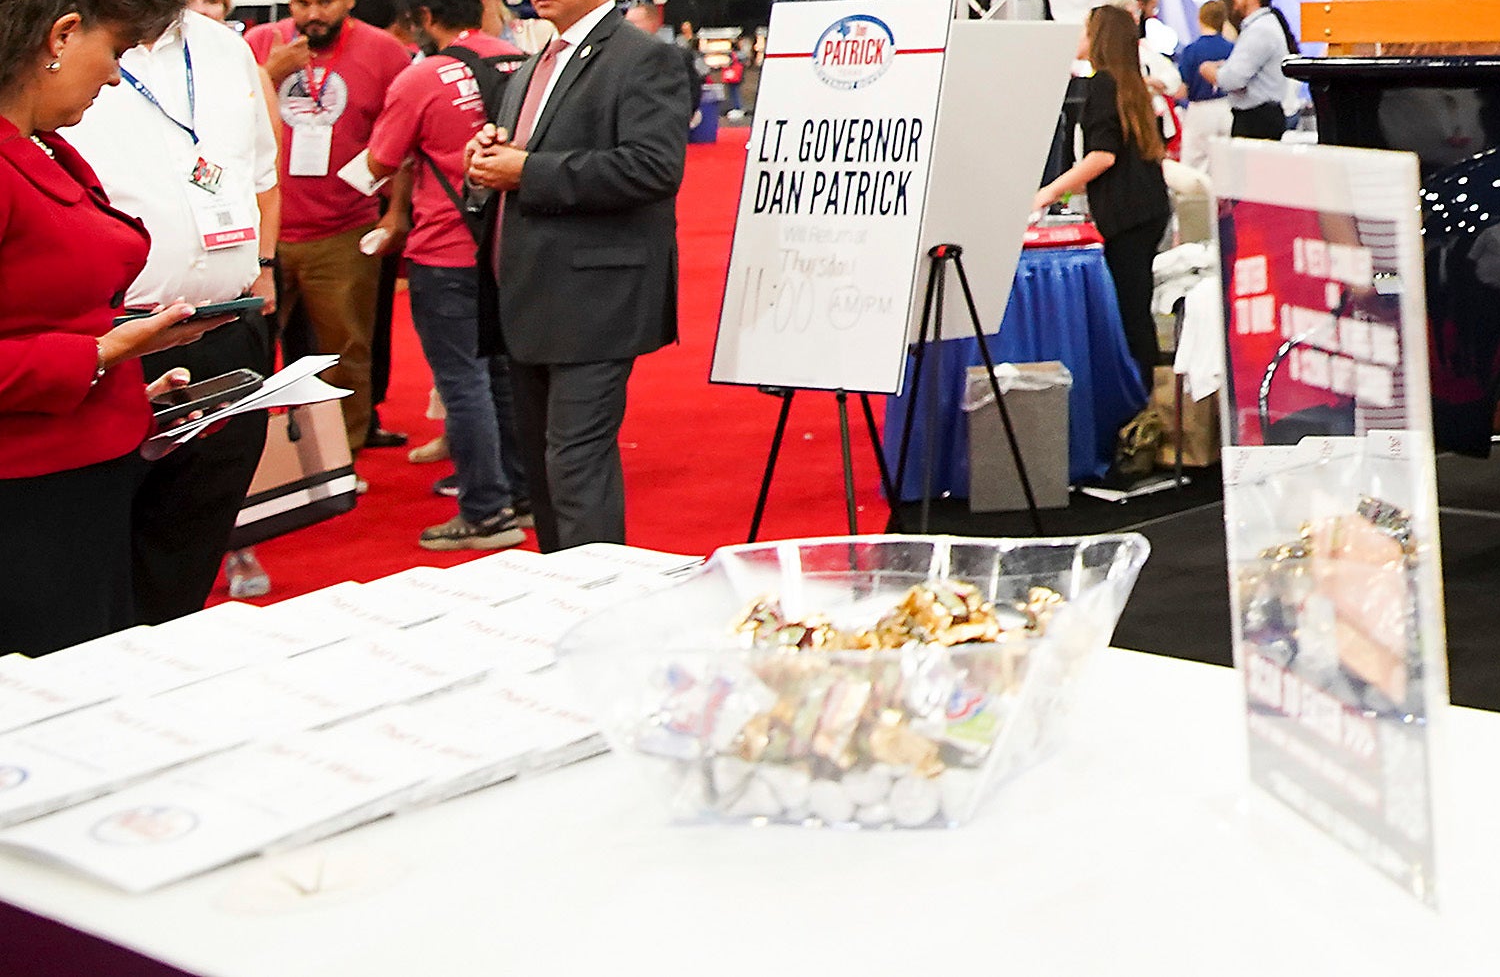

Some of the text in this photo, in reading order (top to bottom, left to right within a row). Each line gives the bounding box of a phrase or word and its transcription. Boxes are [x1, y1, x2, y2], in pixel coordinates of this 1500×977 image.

[822, 38, 886, 66] PATRICK
[758, 118, 923, 163] LT. GOVERNOR
[754, 170, 913, 215] DAN PATRICK
